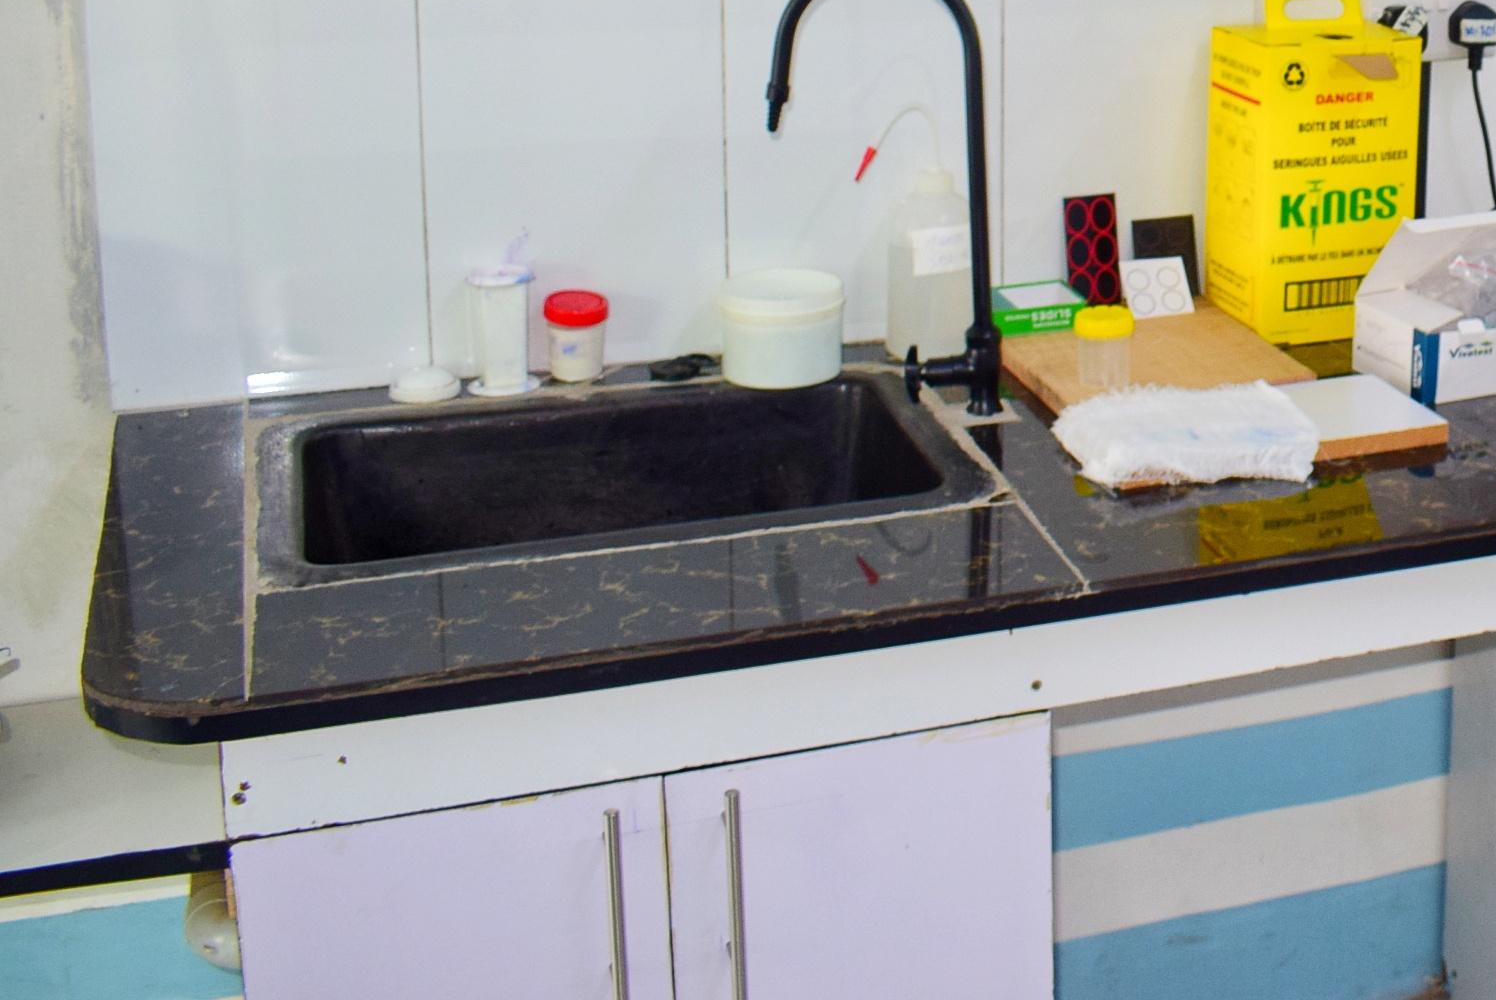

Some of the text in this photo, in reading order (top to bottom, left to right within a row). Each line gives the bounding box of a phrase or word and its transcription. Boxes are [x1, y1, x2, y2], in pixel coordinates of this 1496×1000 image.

[1315, 90, 1375, 105] DANGER
[1329, 120, 1341, 132] DE
[1331, 136, 1356, 147] POUR
